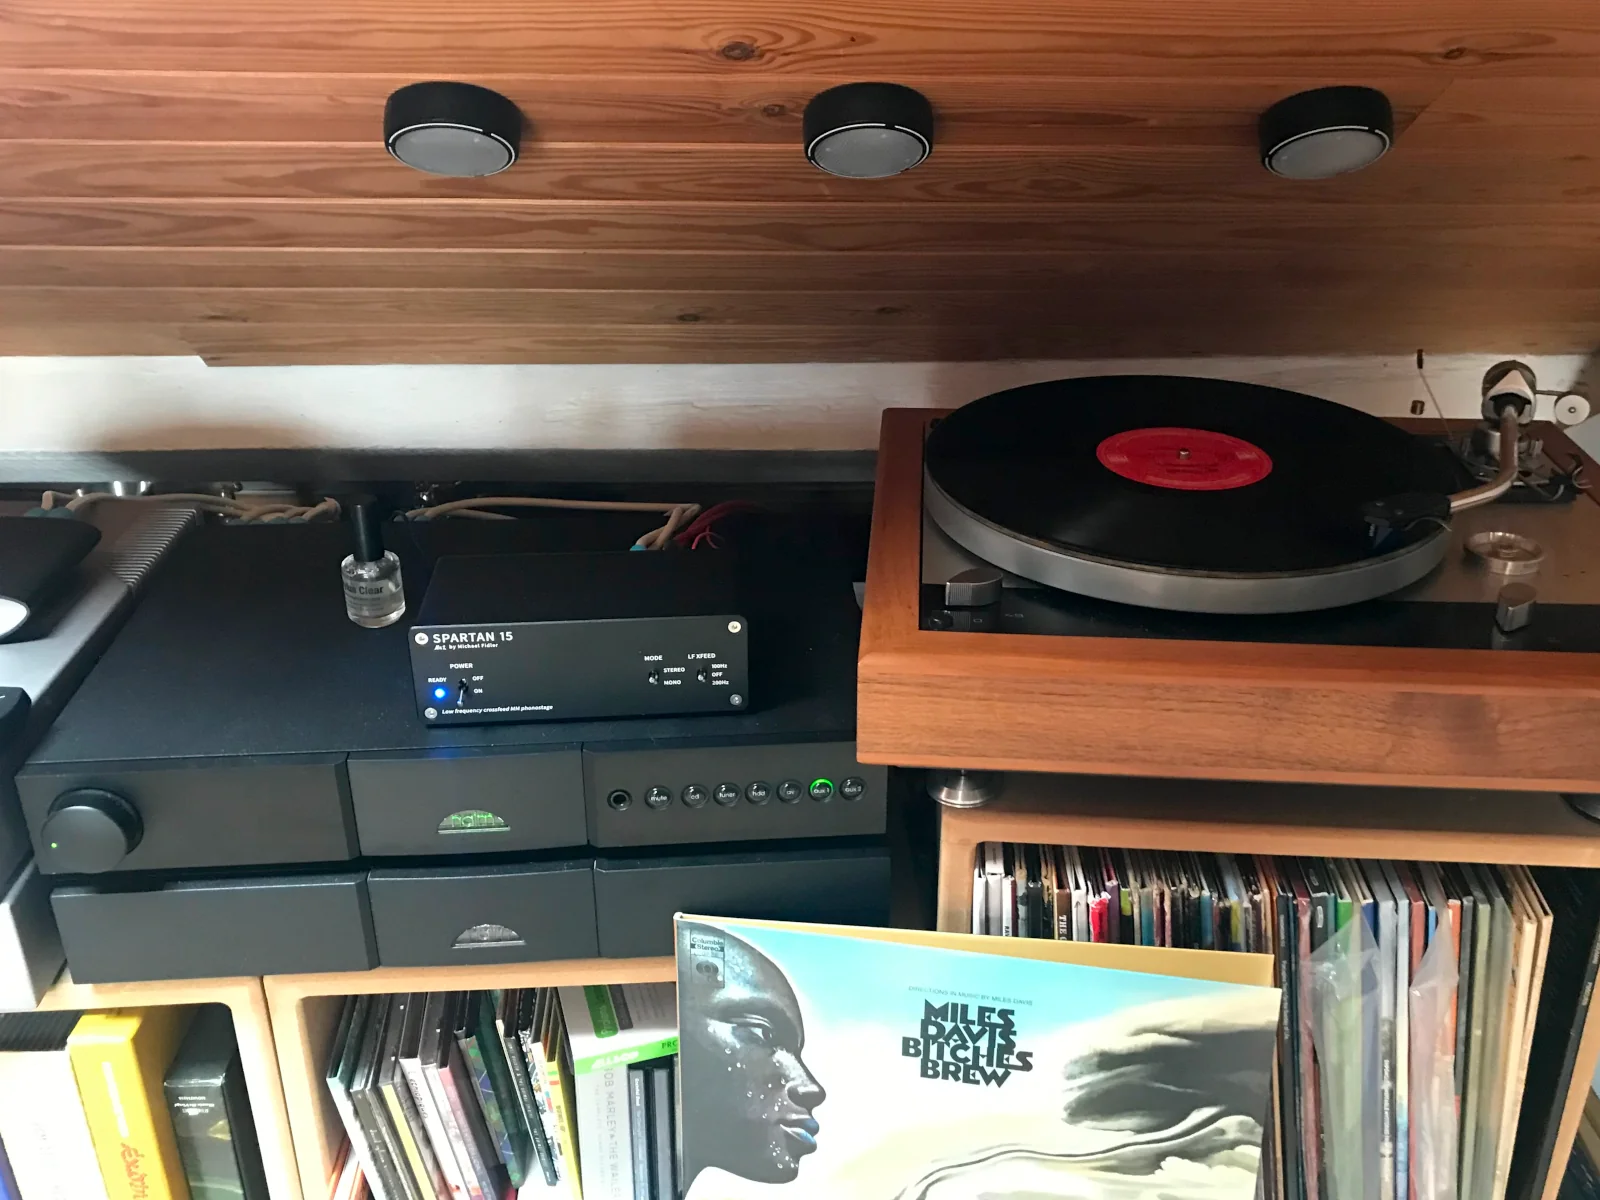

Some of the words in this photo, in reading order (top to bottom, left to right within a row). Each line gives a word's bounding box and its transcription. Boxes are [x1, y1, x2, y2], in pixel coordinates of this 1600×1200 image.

[358, 585, 384, 595] Clear
[432, 632, 495, 644] SPARTAN
[500, 631, 514, 641] 15
[644, 654, 663, 662] MODE
[520, 704, 553, 712] phonostage
[452, 811, 495, 828] naim
[1058, 914, 1067, 934] THE
[696, 944, 720, 952] Stereo
[908, 986, 948, 996] DIRECTIONS
[958, 992, 980, 1000] MUSIC
[992, 996, 1012, 1004] MILES
[1013, 998, 1033, 1006] DAVIS
[924, 998, 1015, 1030] MILES
[920, 1018, 1017, 1049] DAVIS
[902, 1036, 1033, 1072] BITCHES
[920, 1058, 1012, 1088] BREW
[606, 1092, 616, 1131] MARLEY
[609, 1142, 620, 1160] THE
